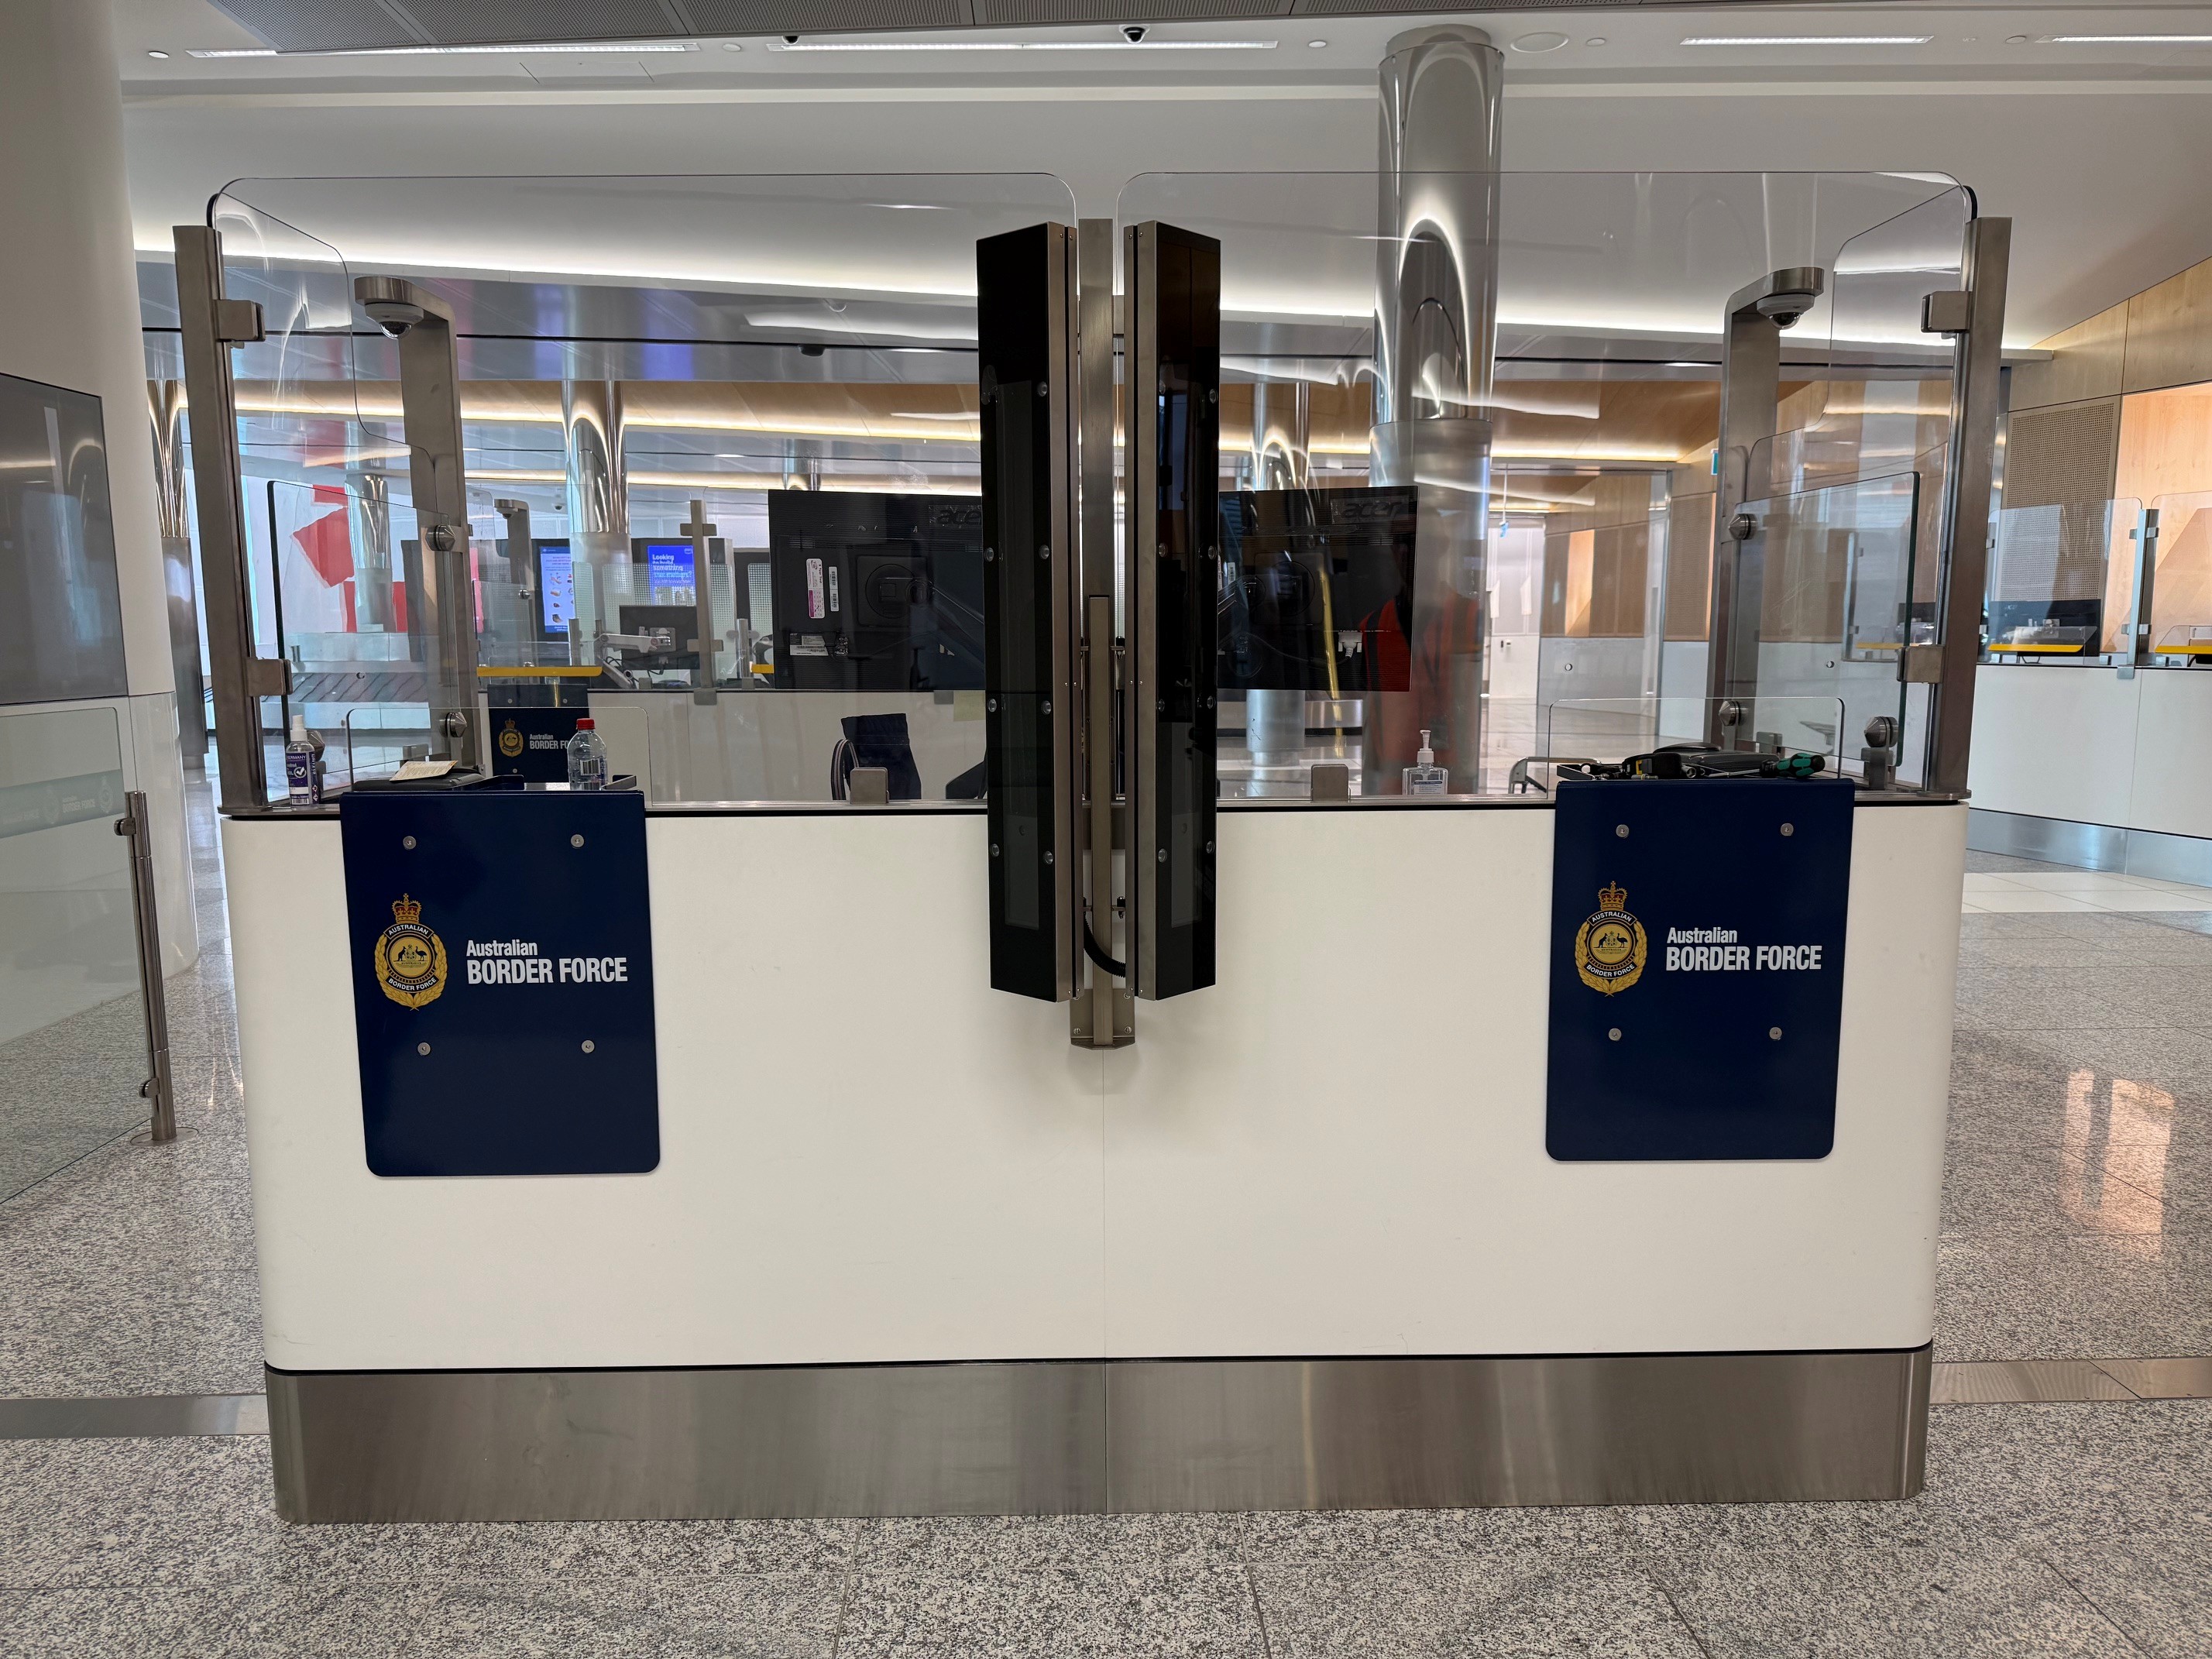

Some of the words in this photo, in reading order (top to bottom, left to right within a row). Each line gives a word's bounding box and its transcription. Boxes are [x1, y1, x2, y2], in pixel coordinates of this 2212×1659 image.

[937, 508, 982, 525] ace
[1342, 502, 1403, 520] acer
[530, 740, 558, 750] BORDER
[1591, 911, 1633, 923] AUSTRALIAN
[388, 923, 429, 936] AUSTRALIAN
[1667, 927, 1738, 943] Australian
[466, 939, 538, 957] Australian
[1666, 946, 1750, 971] BORDER
[1756, 945, 1822, 970] FORCE
[467, 958, 554, 984] BORDER
[558, 957, 628, 983] FORCE
[1586, 964, 1613, 977] BORDER
[1613, 963, 1635, 977] FORCE
[388, 977, 415, 991] BORDER
[416, 977, 437, 991] FORCE
